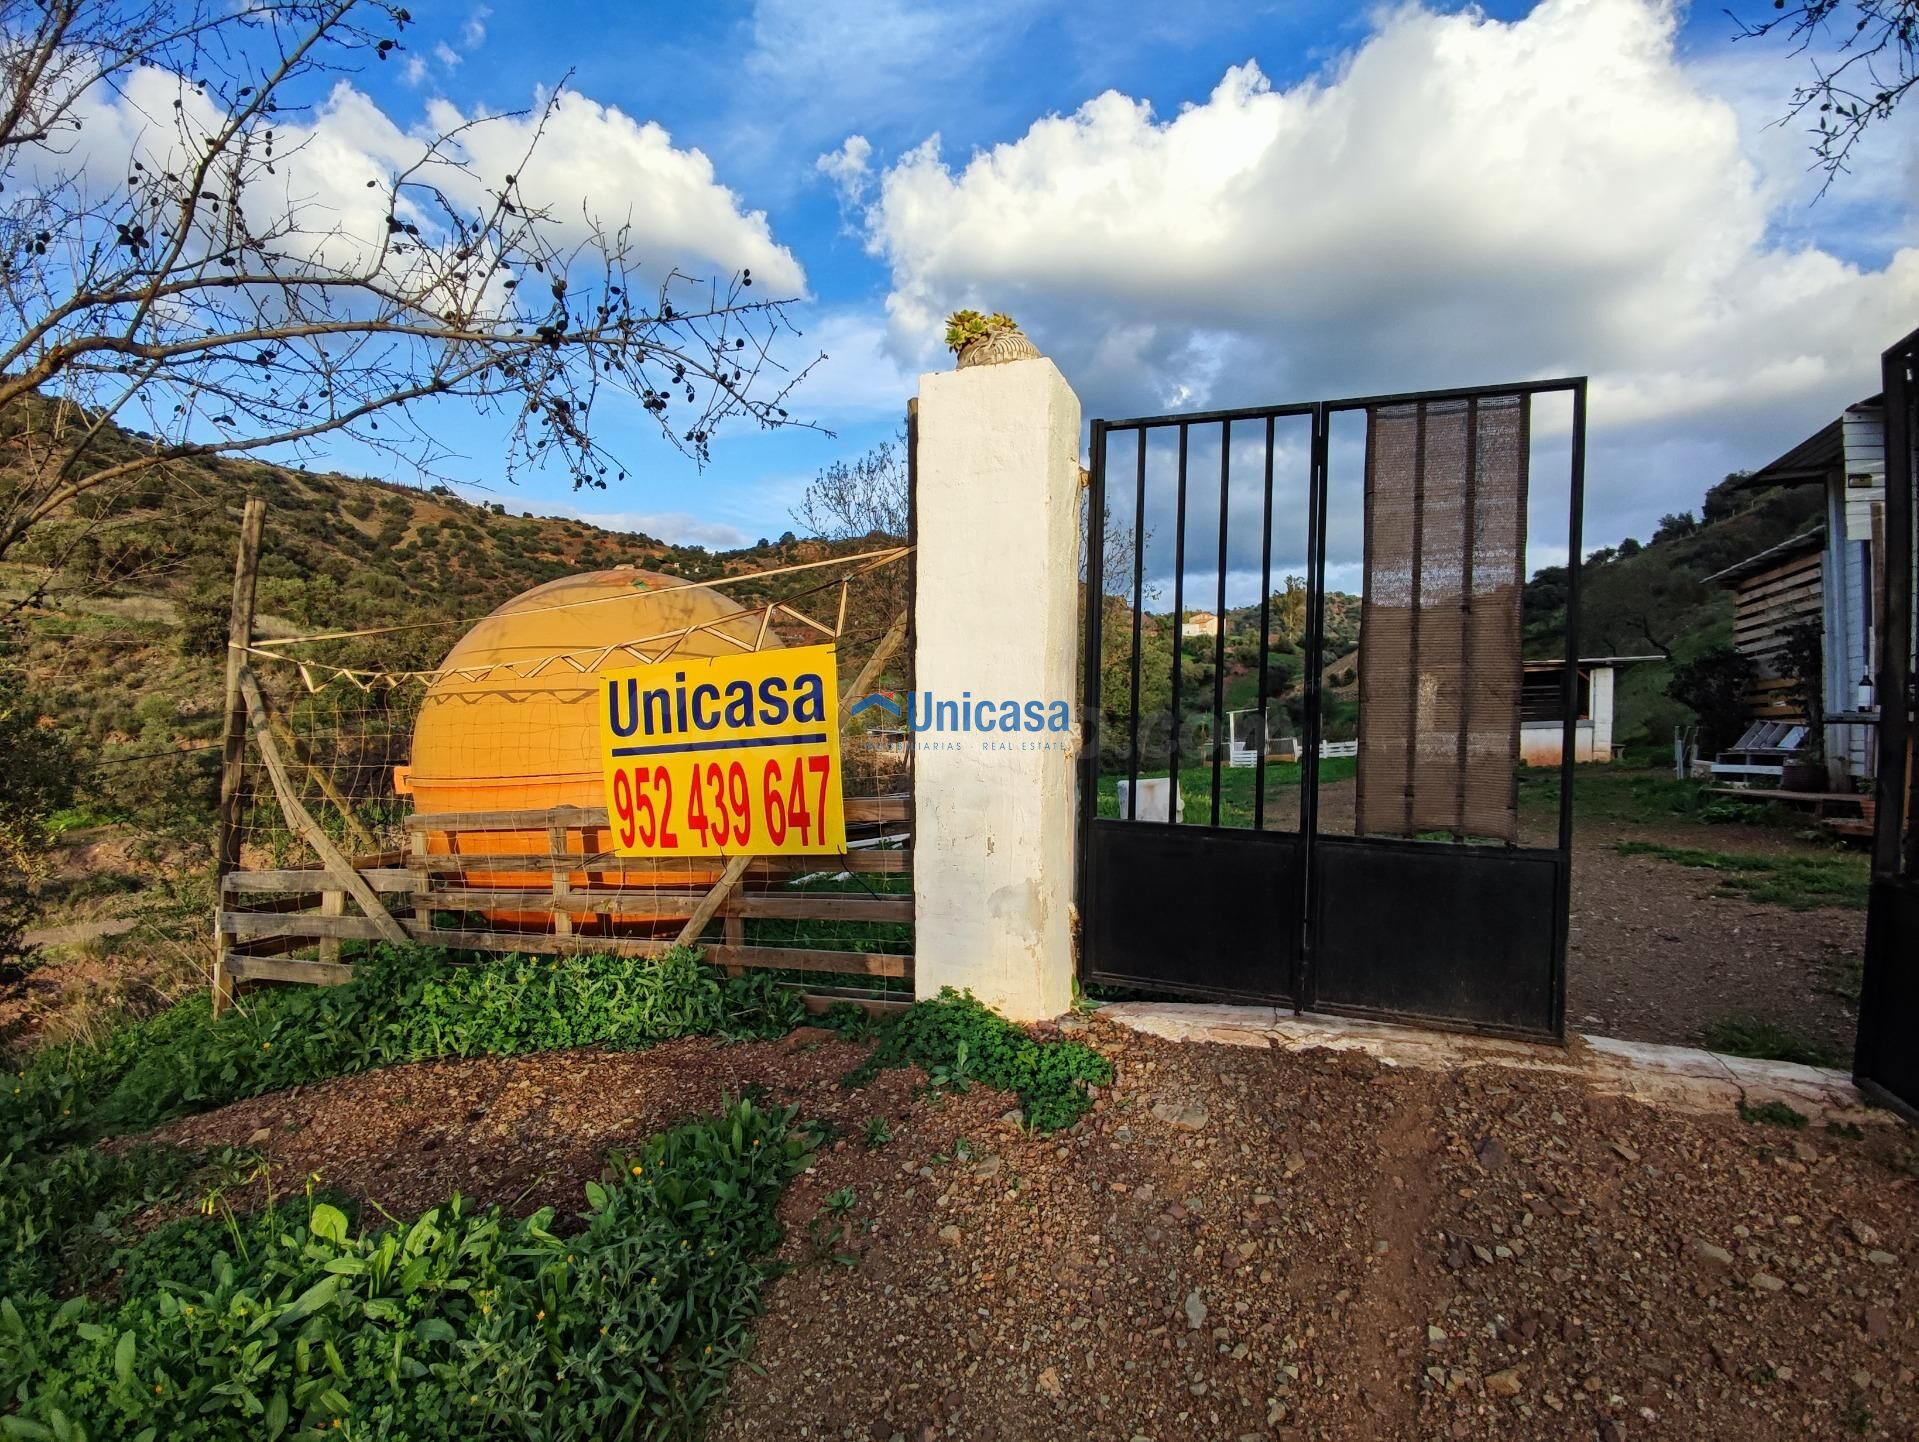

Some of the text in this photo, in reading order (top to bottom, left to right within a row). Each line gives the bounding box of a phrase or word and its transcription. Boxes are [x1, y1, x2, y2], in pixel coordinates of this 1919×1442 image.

[608, 671, 826, 738] Unicasa
[613, 754, 830, 849] 952 439 647
